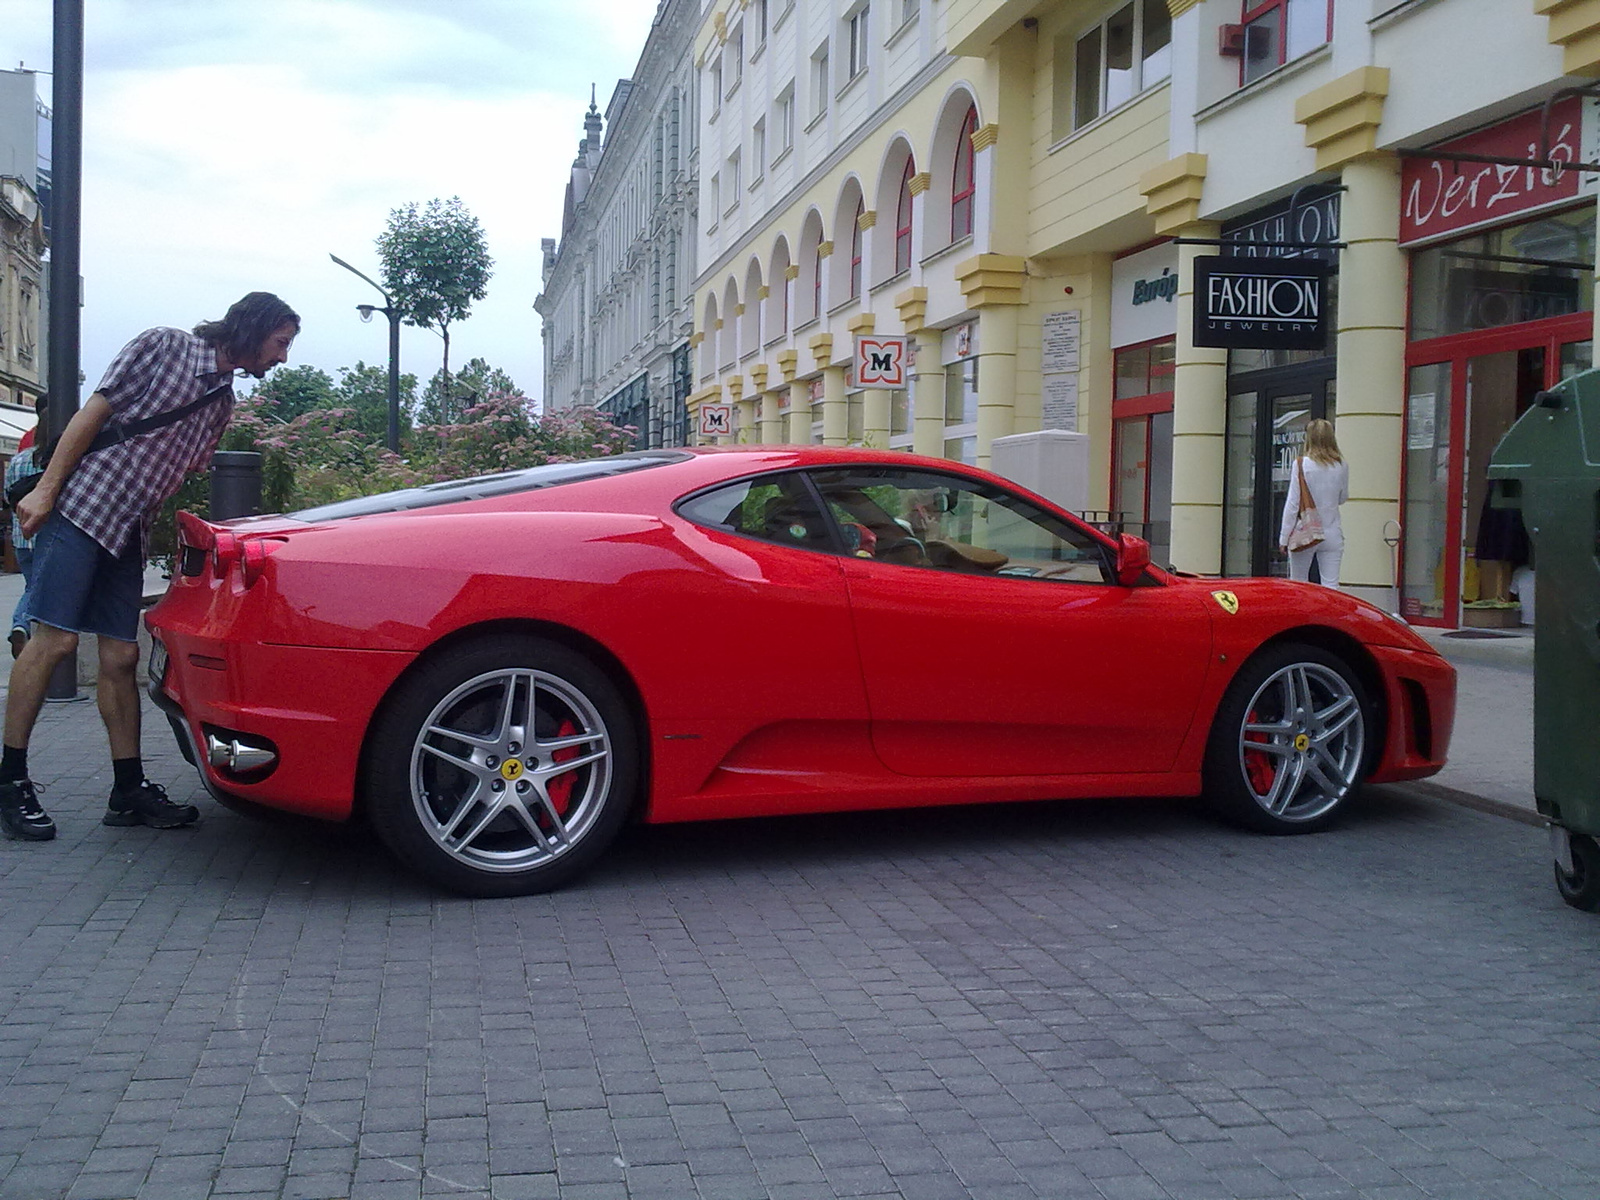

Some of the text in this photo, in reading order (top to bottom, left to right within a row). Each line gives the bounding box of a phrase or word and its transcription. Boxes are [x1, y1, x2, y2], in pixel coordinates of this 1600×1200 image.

[1406, 123, 1573, 226] Verzió
[1233, 197, 1338, 258] FASHON
[1208, 276, 1319, 317] FASHION
[1208, 322, 1318, 332] JEWELRY
[871, 353, 892, 371] M
[709, 414, 723, 426] M
